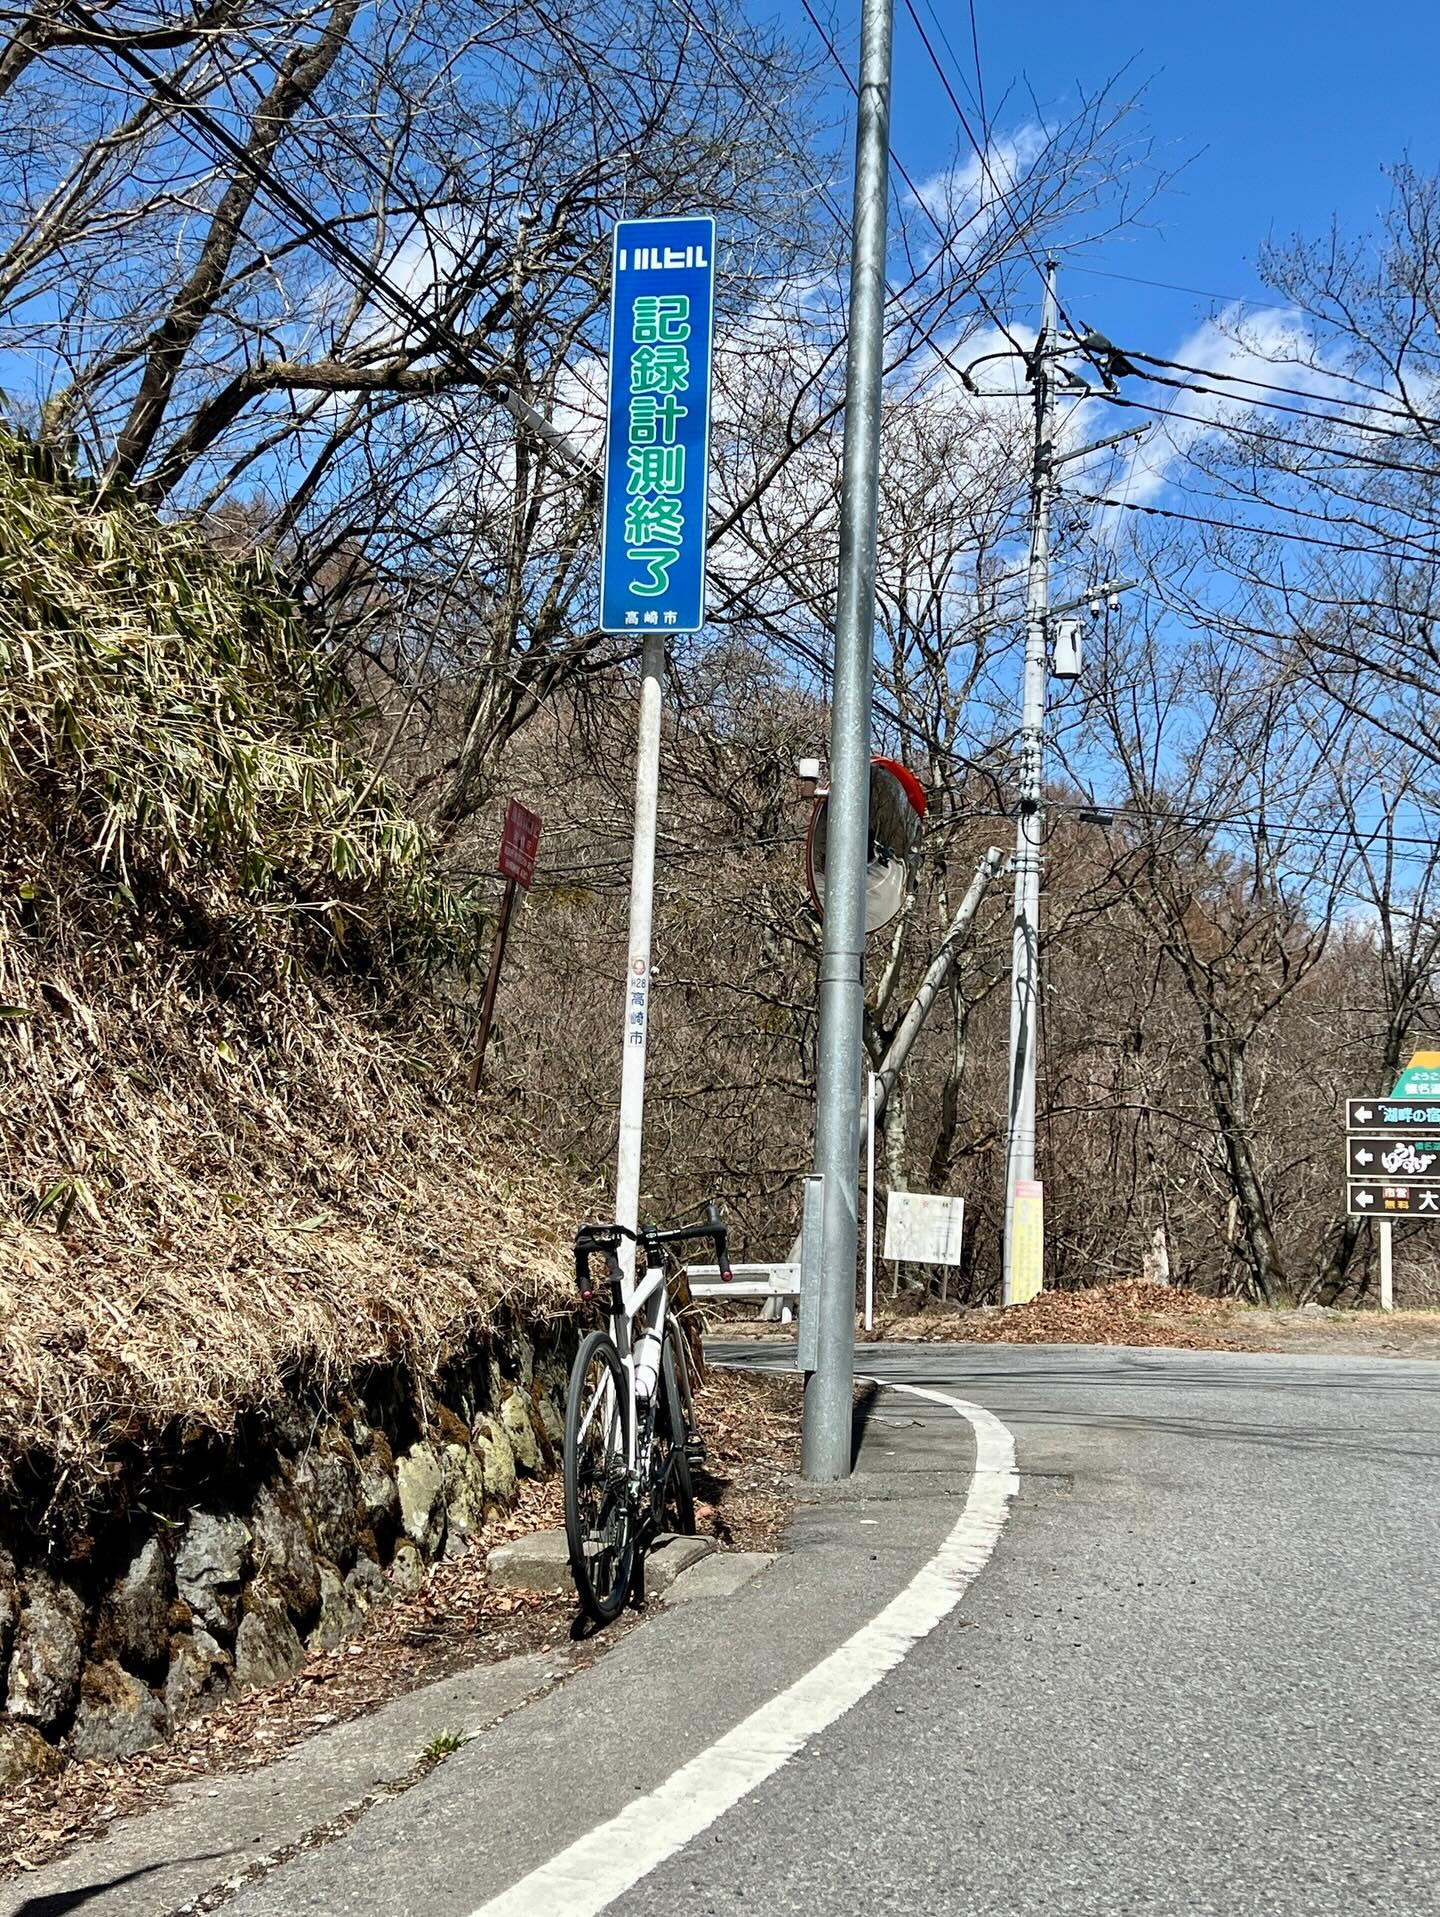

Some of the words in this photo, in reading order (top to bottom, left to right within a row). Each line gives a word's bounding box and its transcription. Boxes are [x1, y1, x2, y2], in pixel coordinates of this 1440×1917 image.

[624, 294, 691, 597] 記録計測終了
[1418, 1190, 1440, 1211] 大
